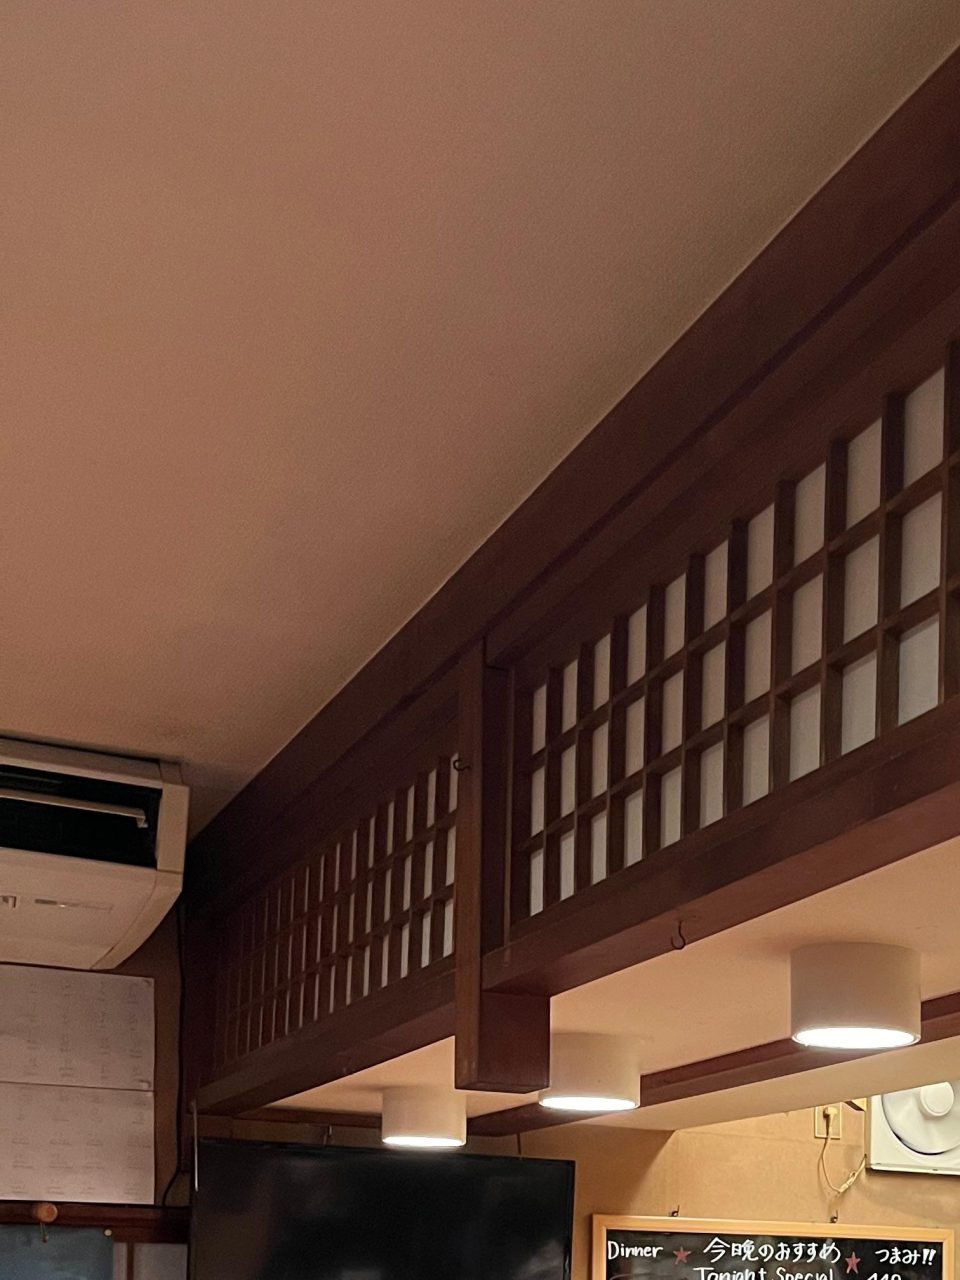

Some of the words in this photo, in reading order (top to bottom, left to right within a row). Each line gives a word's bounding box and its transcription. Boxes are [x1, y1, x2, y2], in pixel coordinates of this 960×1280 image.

[608, 1240, 663, 1260] Dinner
[703, 1236, 842, 1263] 今晩のおすすめ
